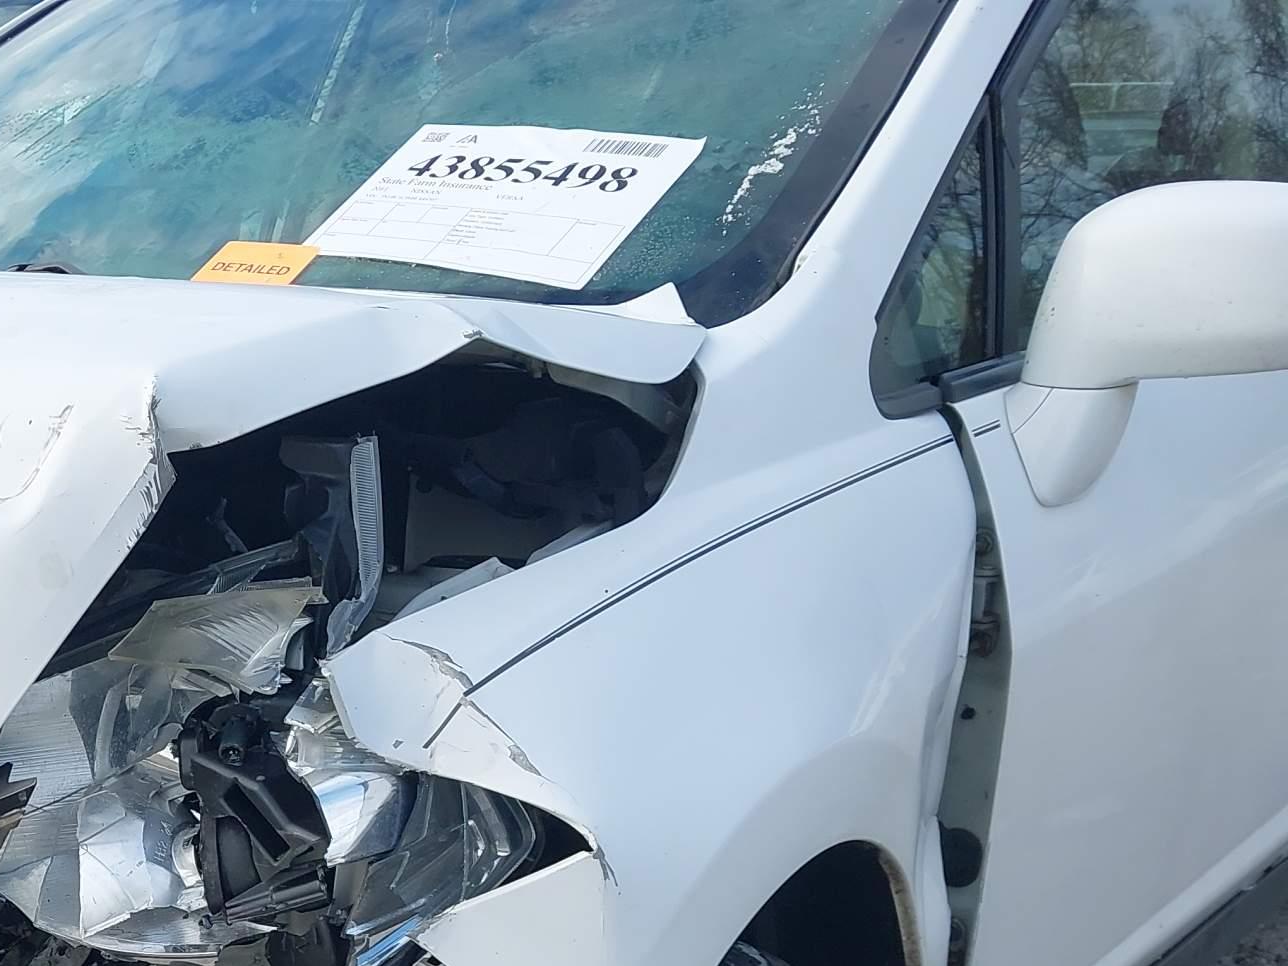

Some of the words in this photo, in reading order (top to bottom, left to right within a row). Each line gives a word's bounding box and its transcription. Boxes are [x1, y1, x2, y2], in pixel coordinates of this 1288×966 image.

[408, 153, 638, 192] 43855498
[378, 176, 406, 186] State
[407, 177, 439, 188] Farm
[439, 179, 493, 191] Insurance
[211, 262, 291, 275] DETAILED
